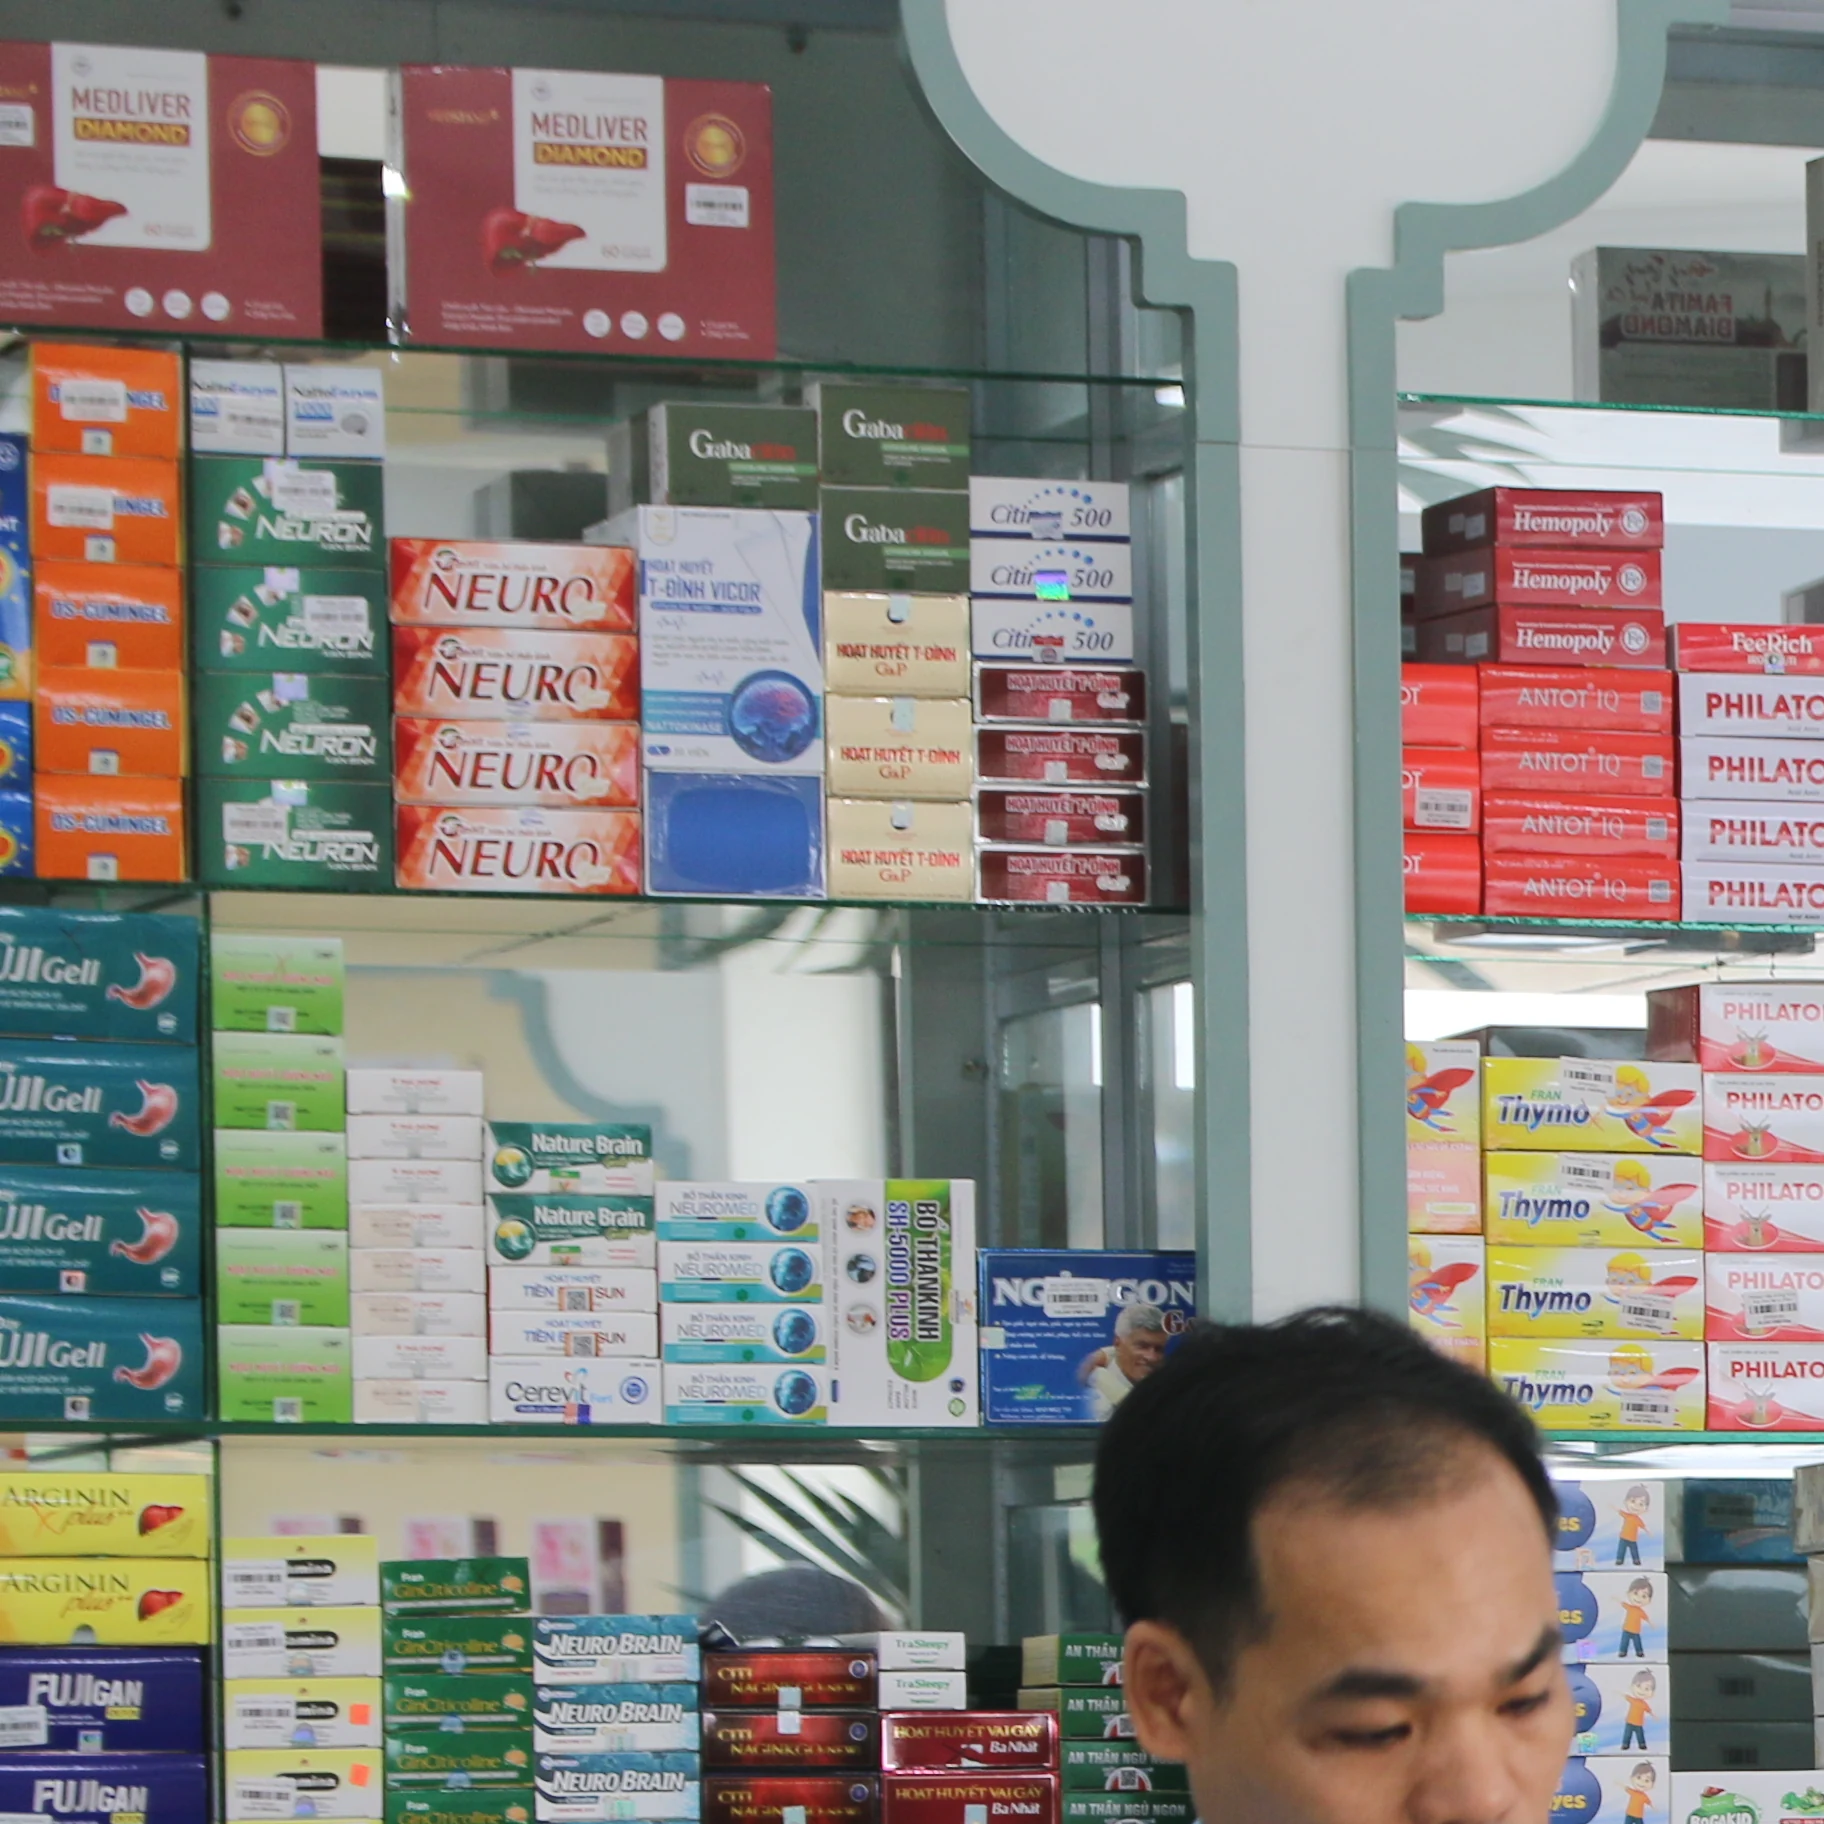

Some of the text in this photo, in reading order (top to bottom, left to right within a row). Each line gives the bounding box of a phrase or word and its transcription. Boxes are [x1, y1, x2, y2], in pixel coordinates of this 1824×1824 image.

[75, 87, 190, 118] MEDLIVER
[257, 516, 372, 544] NEURON
[1514, 512, 1612, 536] Hemopoly
[425, 573, 594, 614] NEURO
[712, 580, 760, 601] VICOR
[1071, 632, 1112, 650] 500
[1732, 633, 1812, 654] FeeRich
[1523, 879, 1628, 902] ANTOT IQ
[533, 1135, 643, 1155] Nature Brain
[887, 1201, 910, 1341] SH-5000 PLUS
[1500, 1283, 1591, 1318] Thymo
[678, 1323, 766, 1338] NEUROMED
[506, 1380, 588, 1402] Cerevit
[3, 1487, 130, 1507] ARGININ
[402, 1572, 424, 1584] Fran
[553, 1632, 682, 1656] NEURO BRAIN
[986, 1724, 1008, 1737] VAI
[34, 1780, 147, 1813] FUJIGAN
[1071, 1803, 1090, 1816] AN
[1152, 1803, 1186, 1816] NGON
